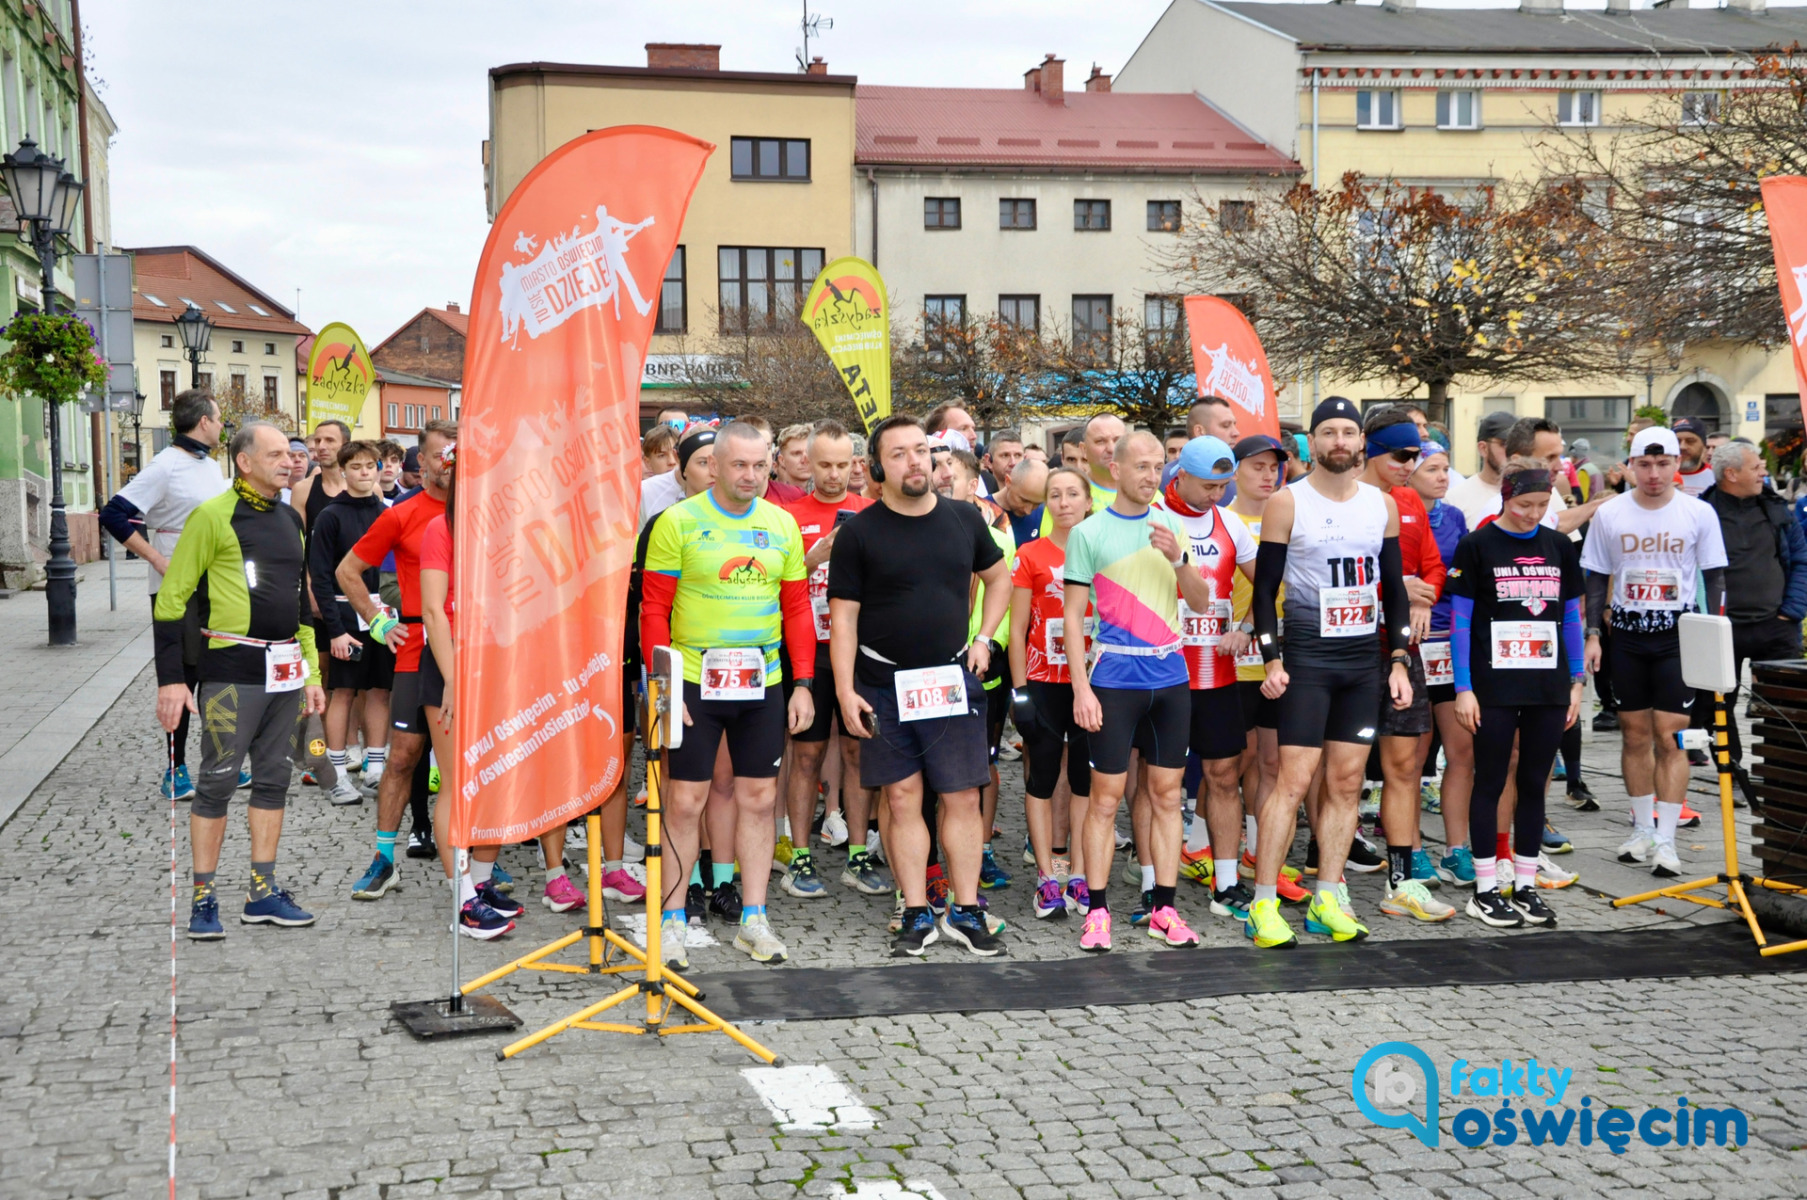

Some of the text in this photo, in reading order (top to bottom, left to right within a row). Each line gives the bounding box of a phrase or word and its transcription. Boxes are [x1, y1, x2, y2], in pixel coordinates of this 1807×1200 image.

[520, 235, 604, 292] MIASTO OŚWIĘCIM
[544, 253, 611, 315] DZIEJE!
[534, 308, 551, 325] TU
[645, 363, 680, 375] BNP
[312, 369, 366, 399] zadyszka
[468, 468, 552, 540] MIASTO
[1621, 532, 1685, 554] Delia
[1493, 566, 1520, 577] UNIA
[1631, 585, 1661, 600] 170
[1332, 607, 1363, 625] 122
[1190, 618, 1219, 635] 189
[1509, 641, 1531, 657] 84
[288, 663, 298, 680] 5
[717, 670, 741, 688] 75
[909, 687, 944, 708] 108
[494, 692, 557, 741] Oświęcim
[562, 677, 580, 695] tu
[471, 755, 620, 840] Promujemy wydarzenia w Oświęcimiu
